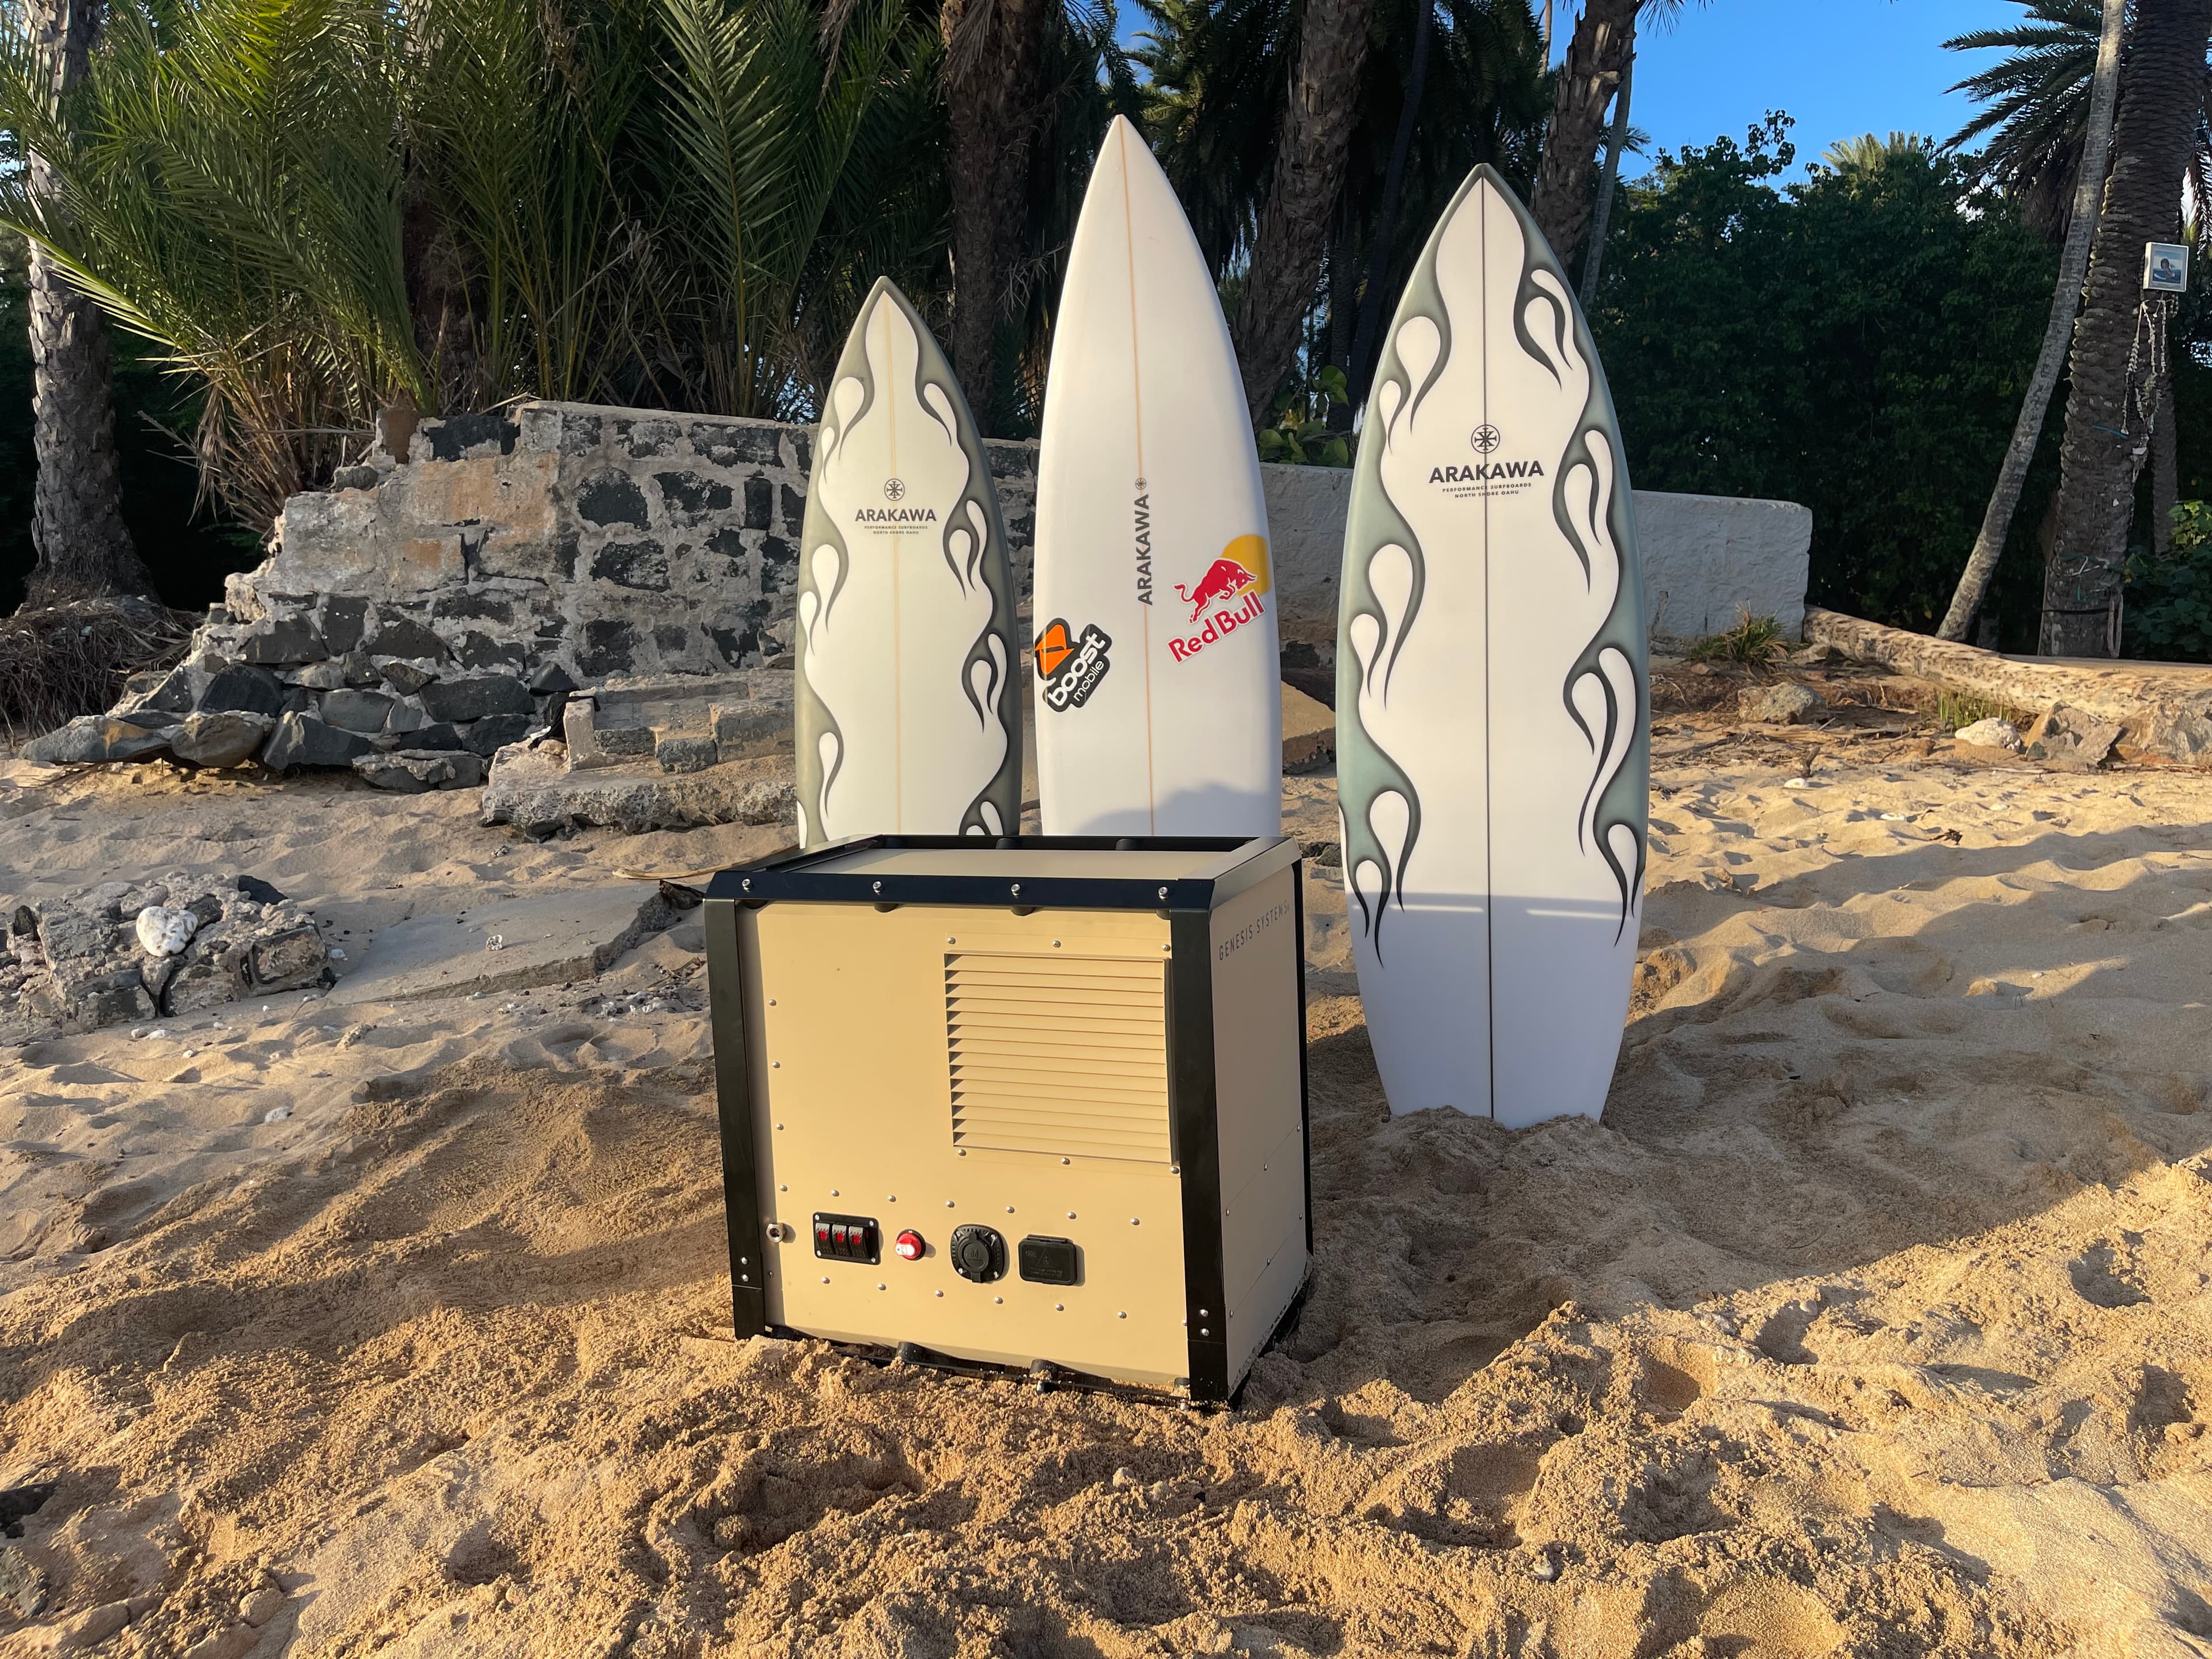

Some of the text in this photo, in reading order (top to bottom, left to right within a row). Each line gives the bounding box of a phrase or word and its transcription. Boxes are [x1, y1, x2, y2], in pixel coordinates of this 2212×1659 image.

[1429, 460, 1544, 484] ARAKAWA
[855, 509, 937, 521] ARAKAWA
[1134, 494, 1153, 605] ARAKAWA
[1168, 590, 1266, 664] Red Bull
[1047, 632, 1106, 706] boost
[1073, 661, 1104, 702] mobile
[1219, 924, 1253, 961] GENESIS
